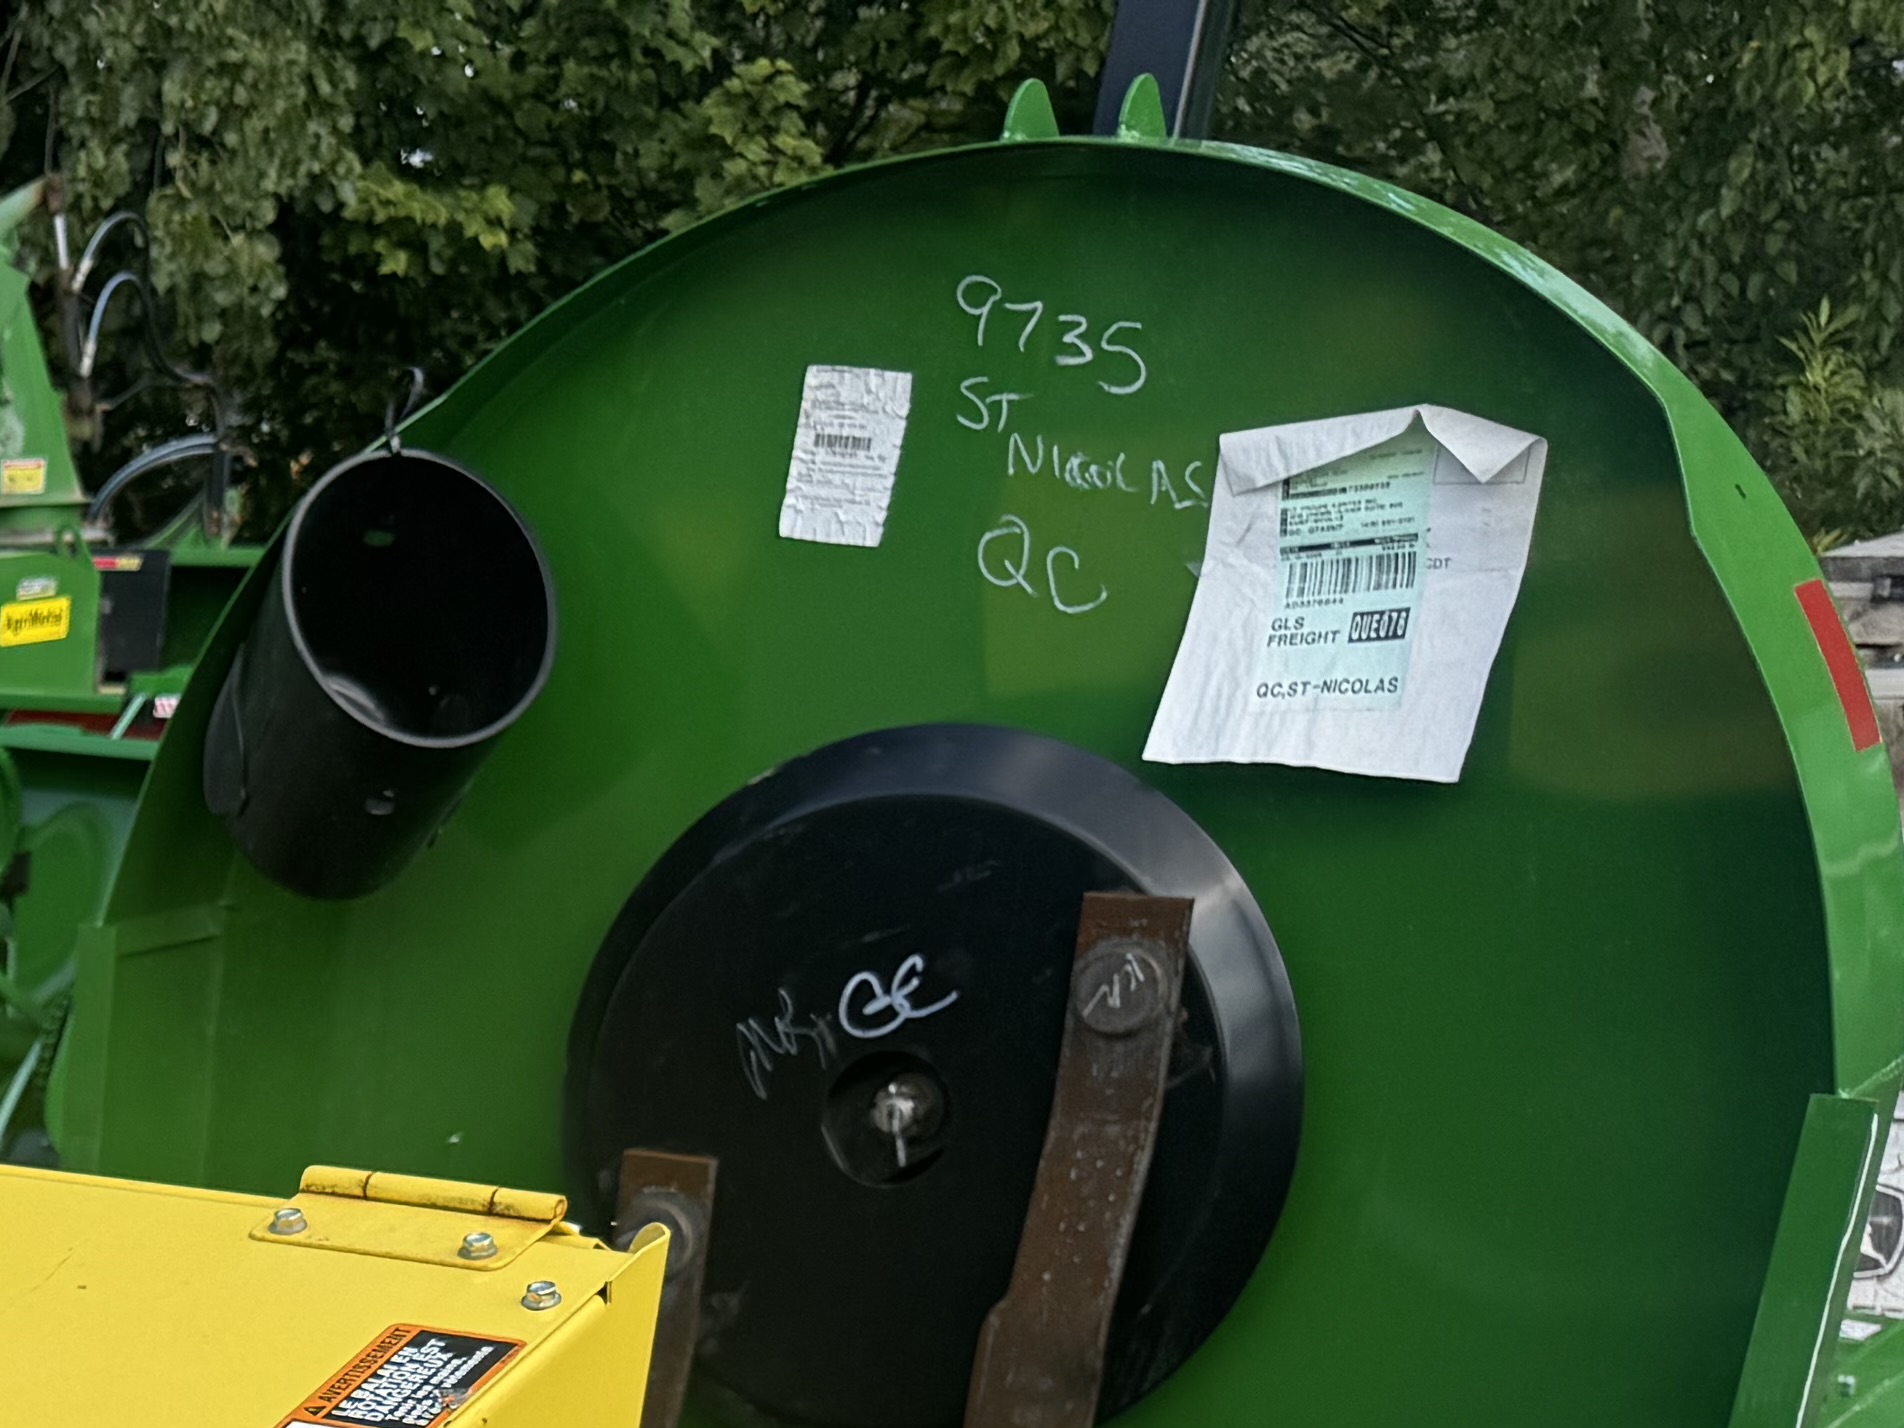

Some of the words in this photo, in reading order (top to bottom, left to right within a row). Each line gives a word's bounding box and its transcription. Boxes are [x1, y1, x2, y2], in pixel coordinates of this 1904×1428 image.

[956, 275, 1147, 395] 9735
[956, 376, 1035, 433] ST
[978, 514, 1109, 614] QC
[1266, 630, 1341, 648] FREIGHT
[1270, 616, 1306, 633] GLS
[316, 1326, 413, 1403] AVERTISSEMENT
[362, 1349, 455, 1422] DANGEREUX
